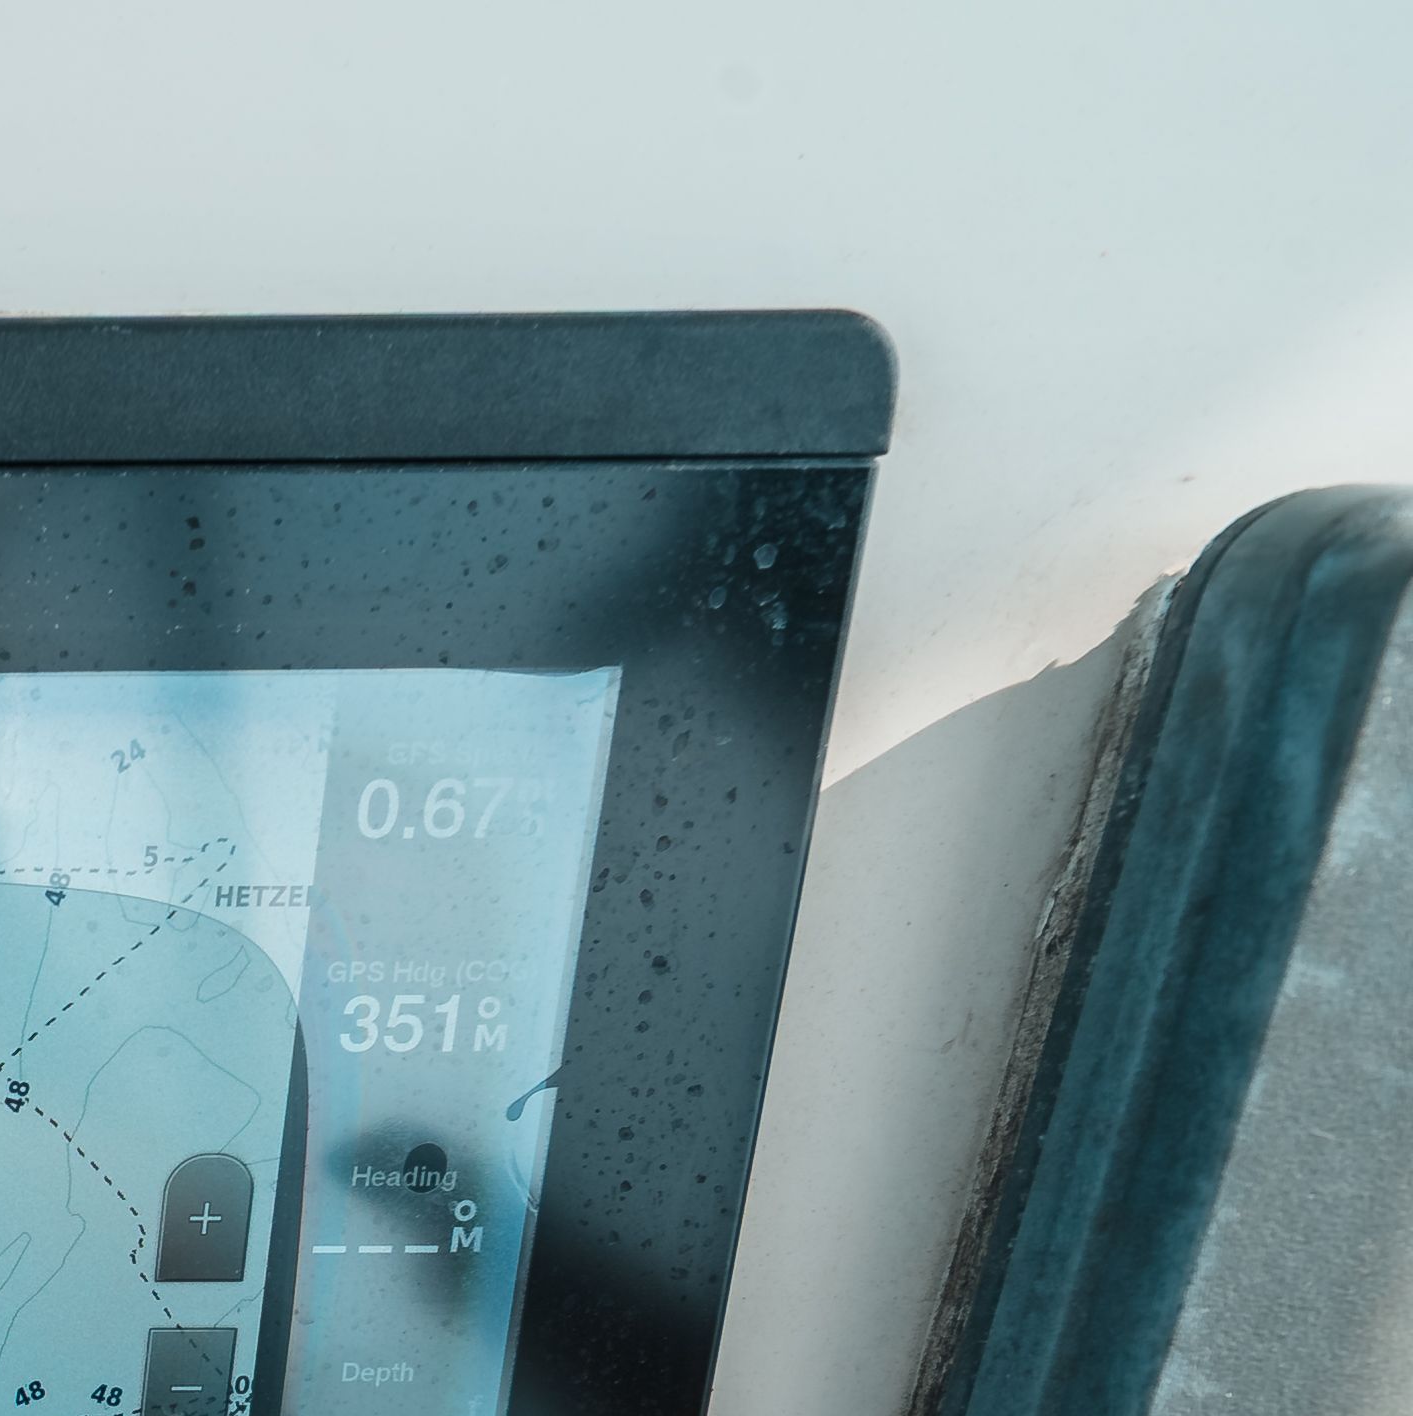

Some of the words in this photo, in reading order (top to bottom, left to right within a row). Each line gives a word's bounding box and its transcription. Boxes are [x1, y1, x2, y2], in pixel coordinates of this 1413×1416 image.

[110, 739, 146, 774] 24
[358, 779, 511, 840] 0.67
[46, 872, 71, 906] 48
[328, 961, 384, 983] GPS
[394, 961, 446, 987] Hdg
[340, 995, 461, 1052] 351
[5, 1080, 30, 1113] 48
[351, 1166, 457, 1191] Heading
[342, 1362, 414, 1387] Depth
[15, 1381, 45, 1406] 48
[91, 1384, 123, 1407] 48
